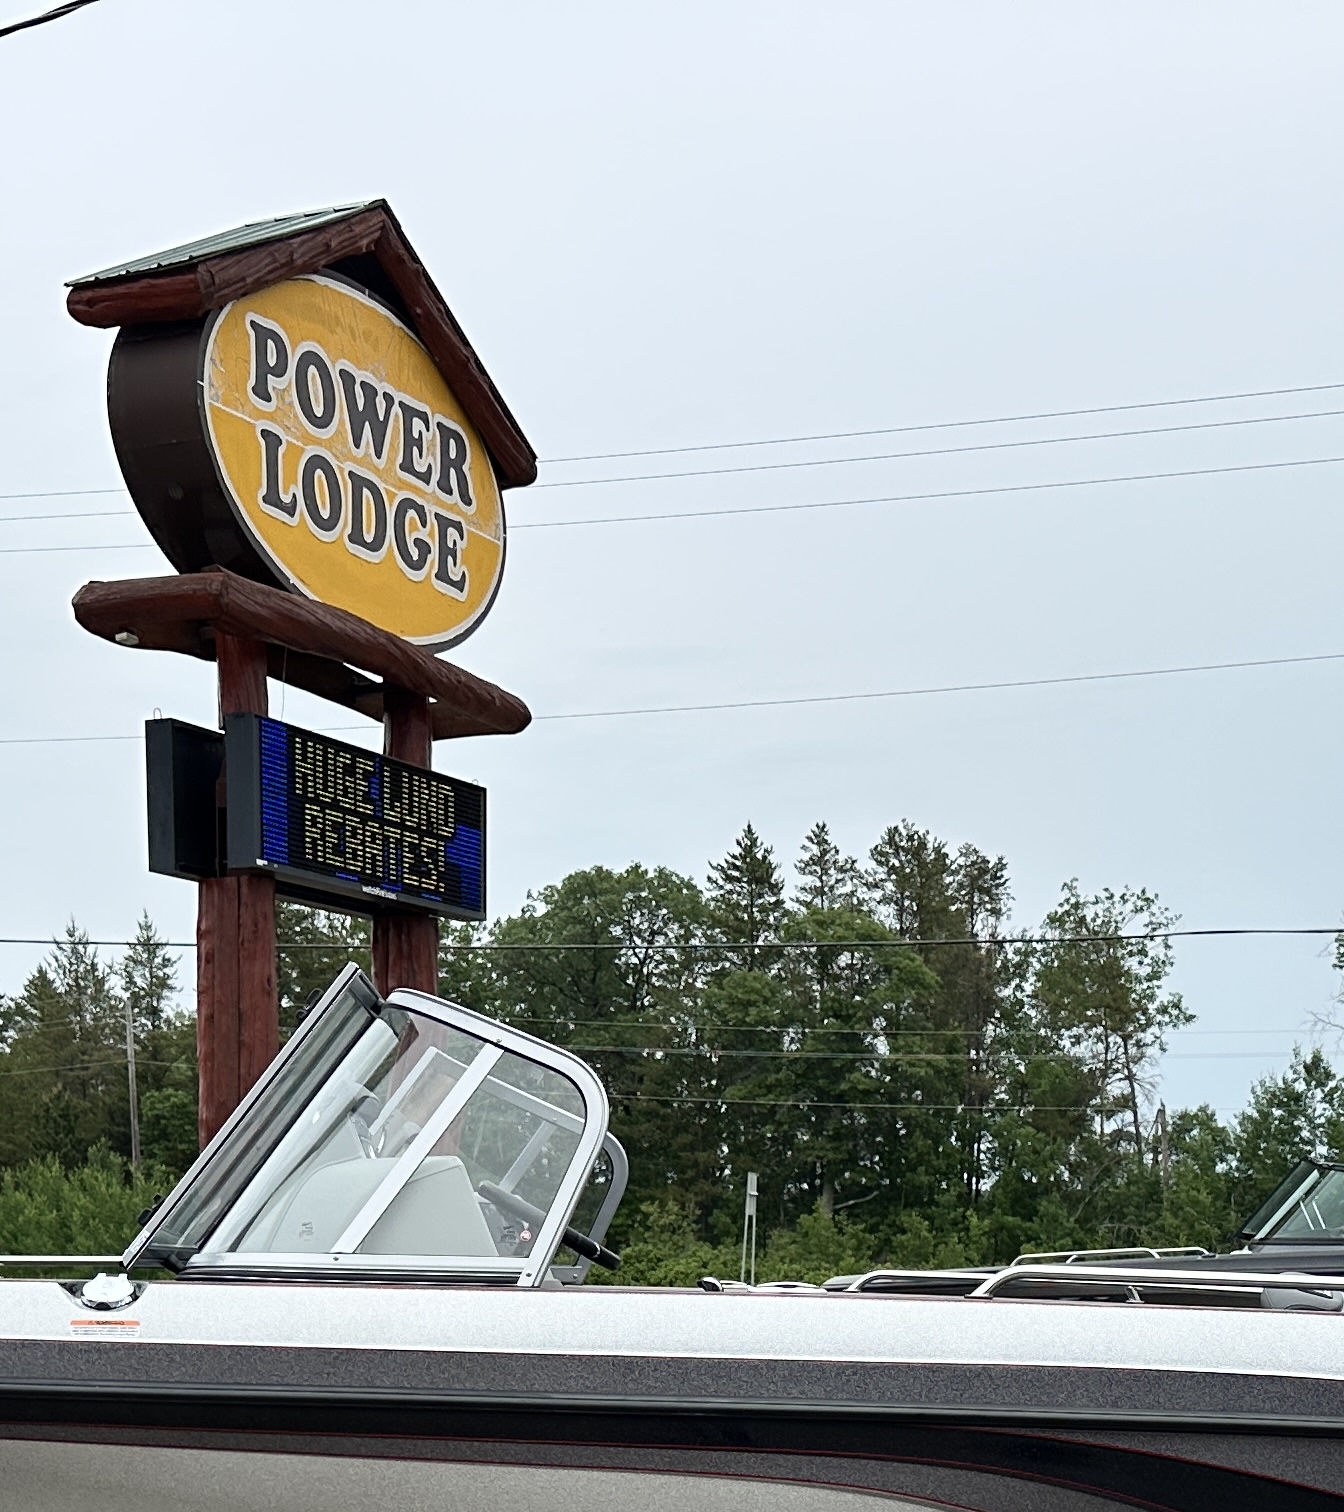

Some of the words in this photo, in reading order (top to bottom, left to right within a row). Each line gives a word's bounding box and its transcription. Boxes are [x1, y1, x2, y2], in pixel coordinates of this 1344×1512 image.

[247, 316, 474, 509] POWER
[258, 427, 470, 597] LODGE
[295, 735, 375, 816] HUGE
[382, 765, 456, 838] LUND
[304, 803, 446, 892] REBATES!
